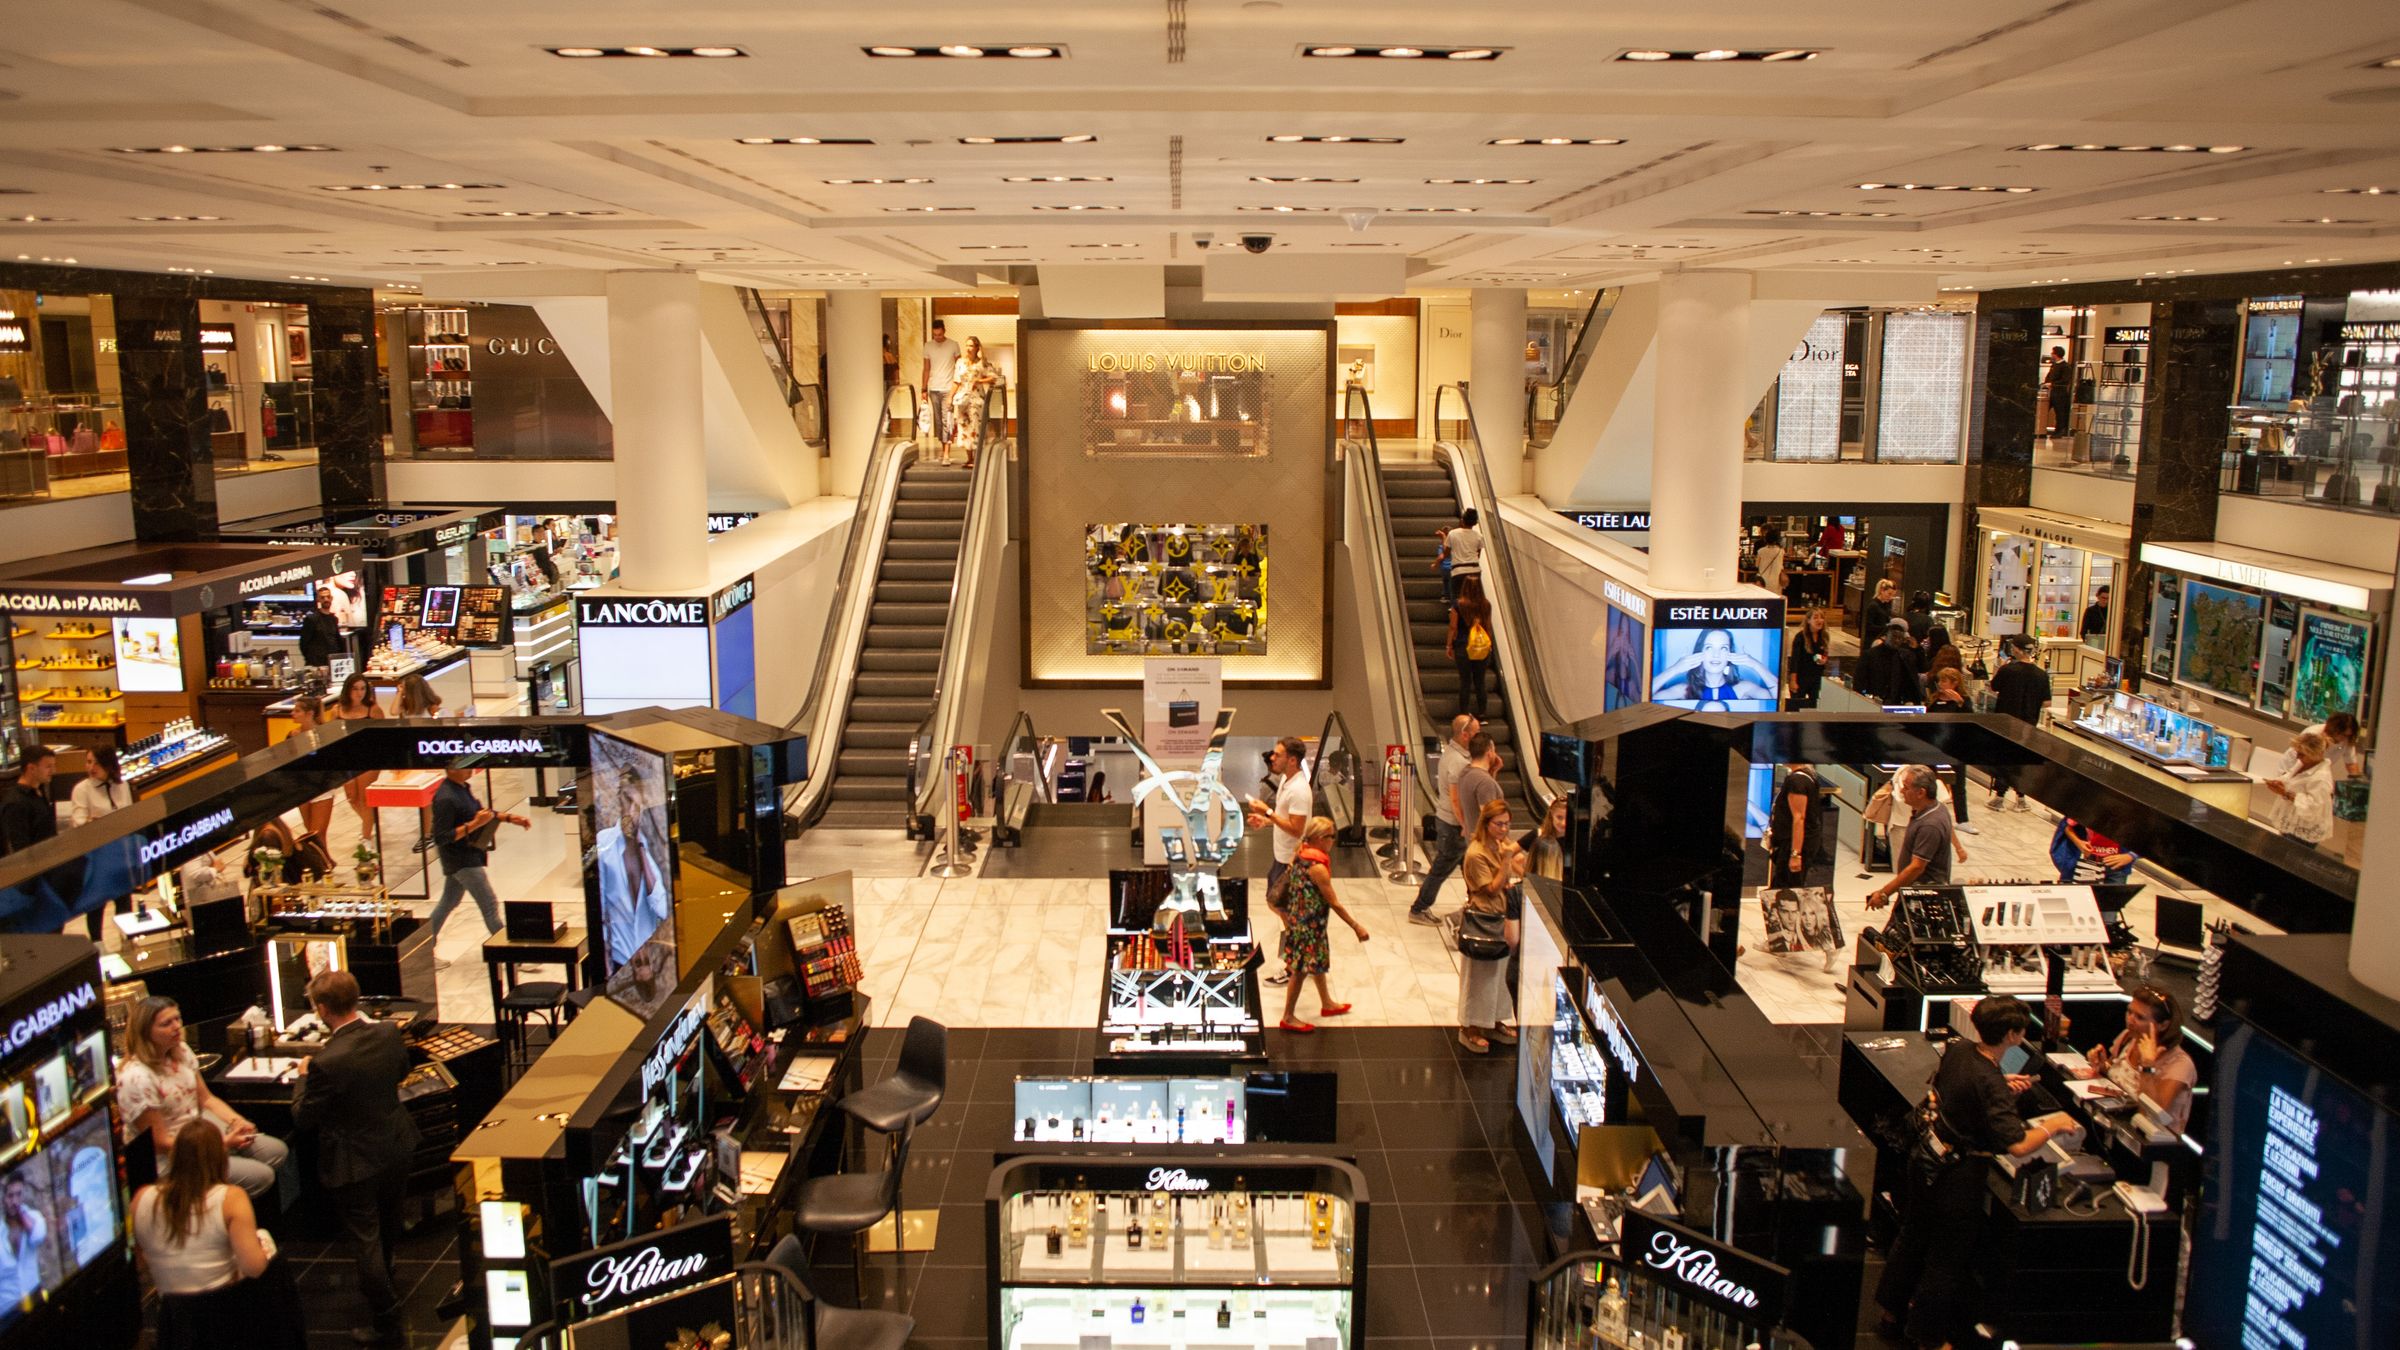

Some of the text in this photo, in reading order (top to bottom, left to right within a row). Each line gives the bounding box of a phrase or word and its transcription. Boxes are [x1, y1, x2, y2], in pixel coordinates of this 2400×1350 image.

[1439, 327, 1463, 338] Dior
[488, 337, 554, 356] GUC
[1088, 353, 1267, 373] LOUIS VUITTON
[706, 516, 734, 531] ME
[238, 574, 275, 595] ACQUA
[281, 564, 314, 582] PARMA
[0, 594, 61, 611] ACQUA
[77, 596, 141, 612] PARMA
[582, 600, 704, 624] LANCÔME
[1713, 607, 1768, 620] LAUDER
[2268, 1104, 2316, 1147] EXPERIENCE
[2265, 1131, 2319, 1180] APPLICAZIONI
[1145, 1166, 1210, 1193] Kilian
[2260, 1168, 2286, 1198] FOCUS
[581, 1246, 708, 1305] Kilian
[1644, 1230, 1760, 1309] Kilian
[2284, 1254, 2321, 1295] SERVICES
